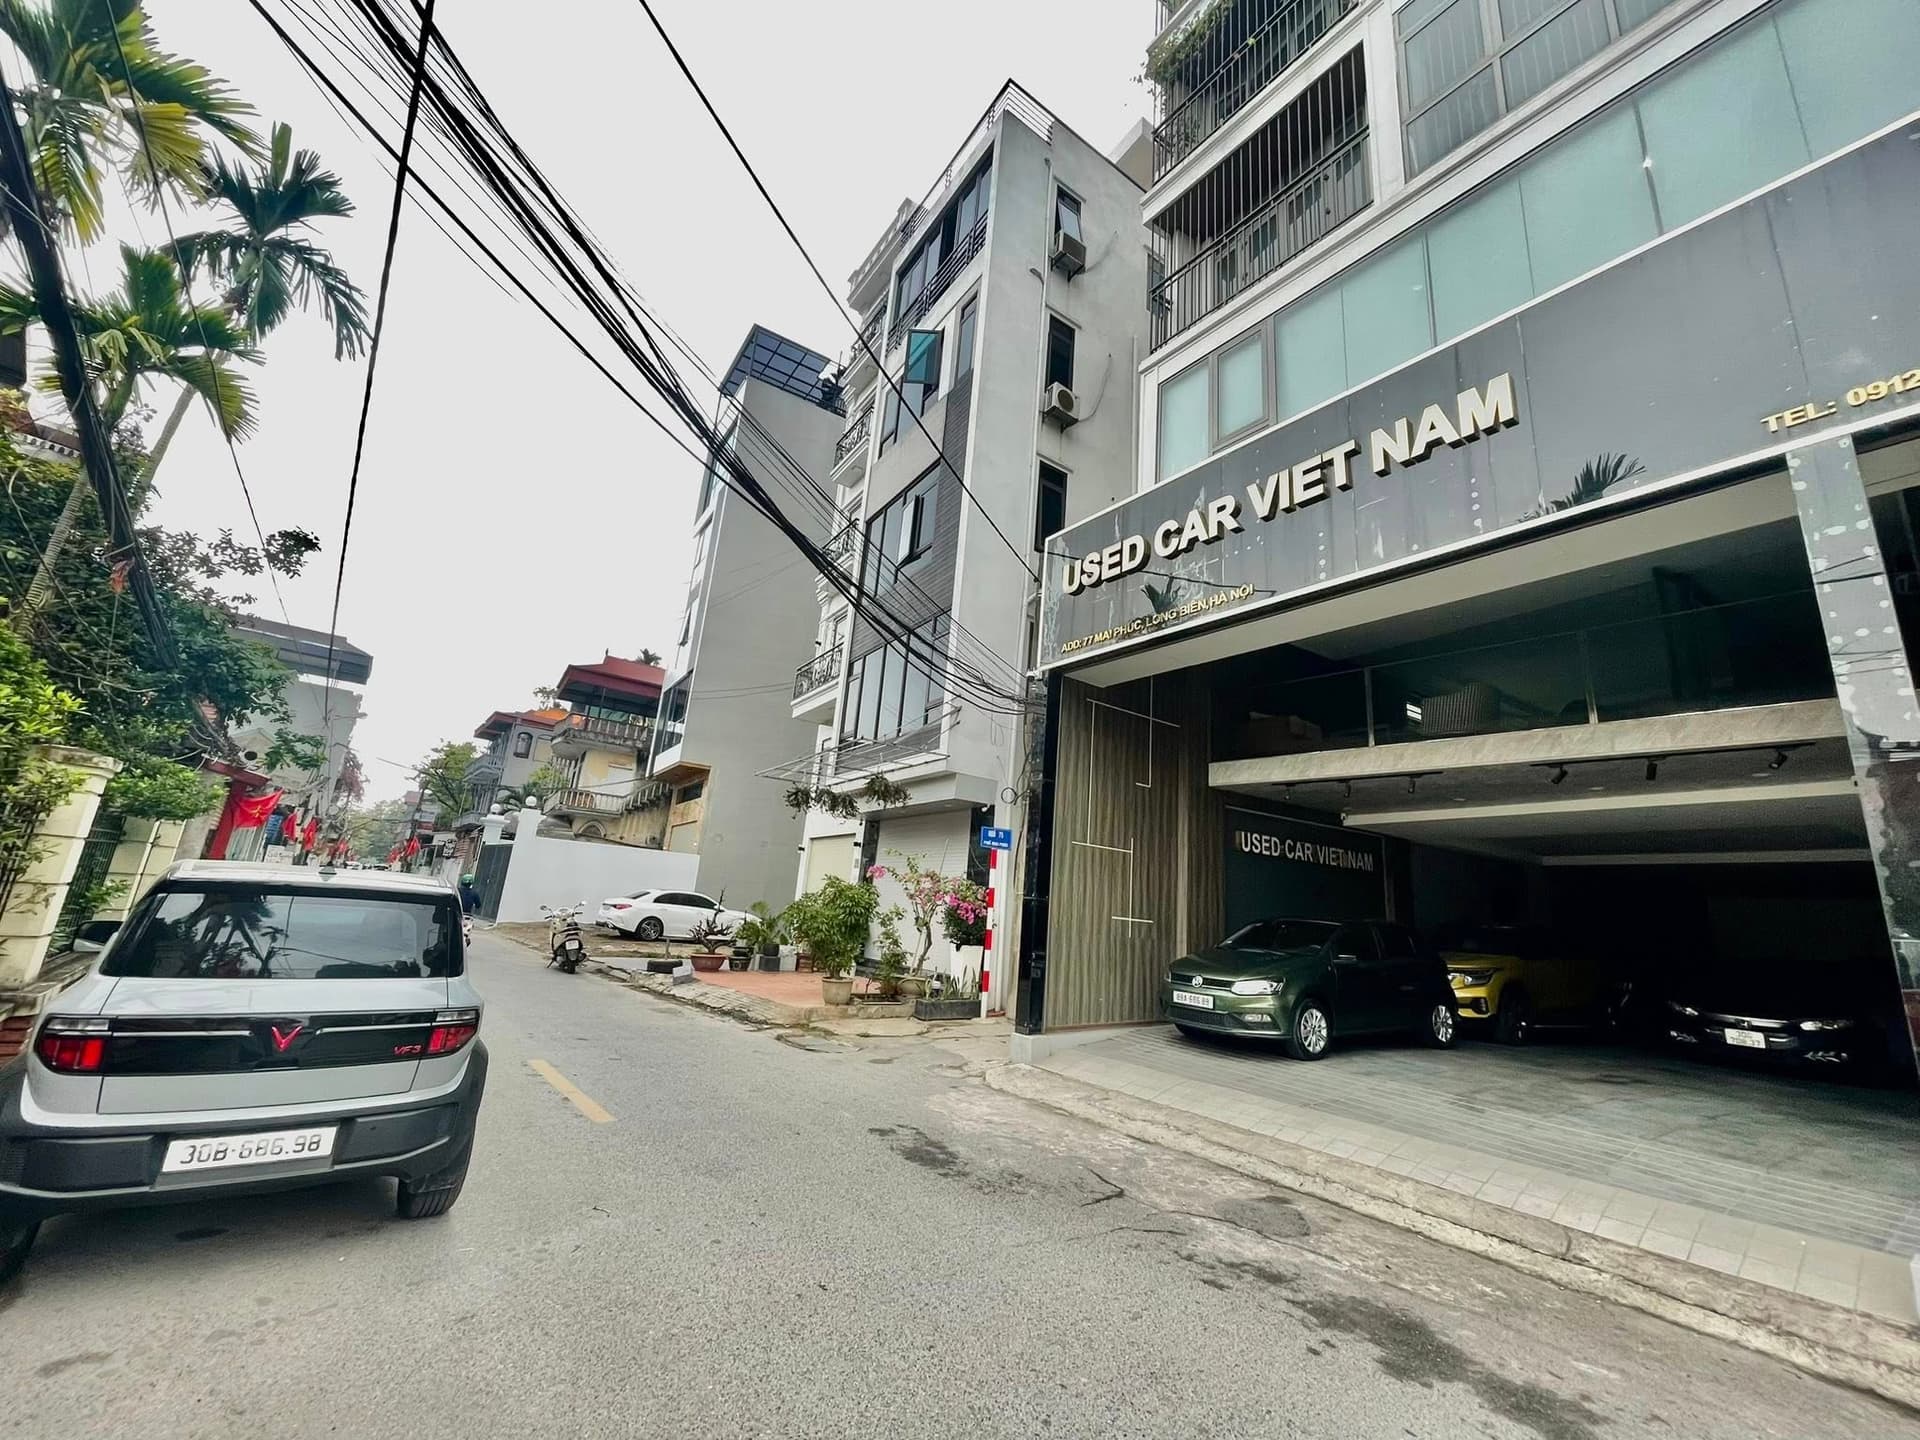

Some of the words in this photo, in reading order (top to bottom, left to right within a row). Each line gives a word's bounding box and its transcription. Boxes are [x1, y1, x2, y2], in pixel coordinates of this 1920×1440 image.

[1760, 401, 1837, 433] TEL:
[1846, 369, 1920, 408] 0912
[1062, 534, 1149, 596] USED
[1153, 494, 1244, 559] CAR
[1246, 439, 1361, 522] VIET
[1370, 372, 1519, 477] NAM
[1061, 639, 1082, 654] ADD:
[1083, 635, 1094, 646] 77
[1094, 628, 1112, 643] MAI
[1145, 608, 1177, 627] LONG
[1241, 831, 1280, 857] USED
[1285, 839, 1314, 862] CAR
[1316, 844, 1345, 868] VIET
[1346, 850, 1374, 872] NAM
